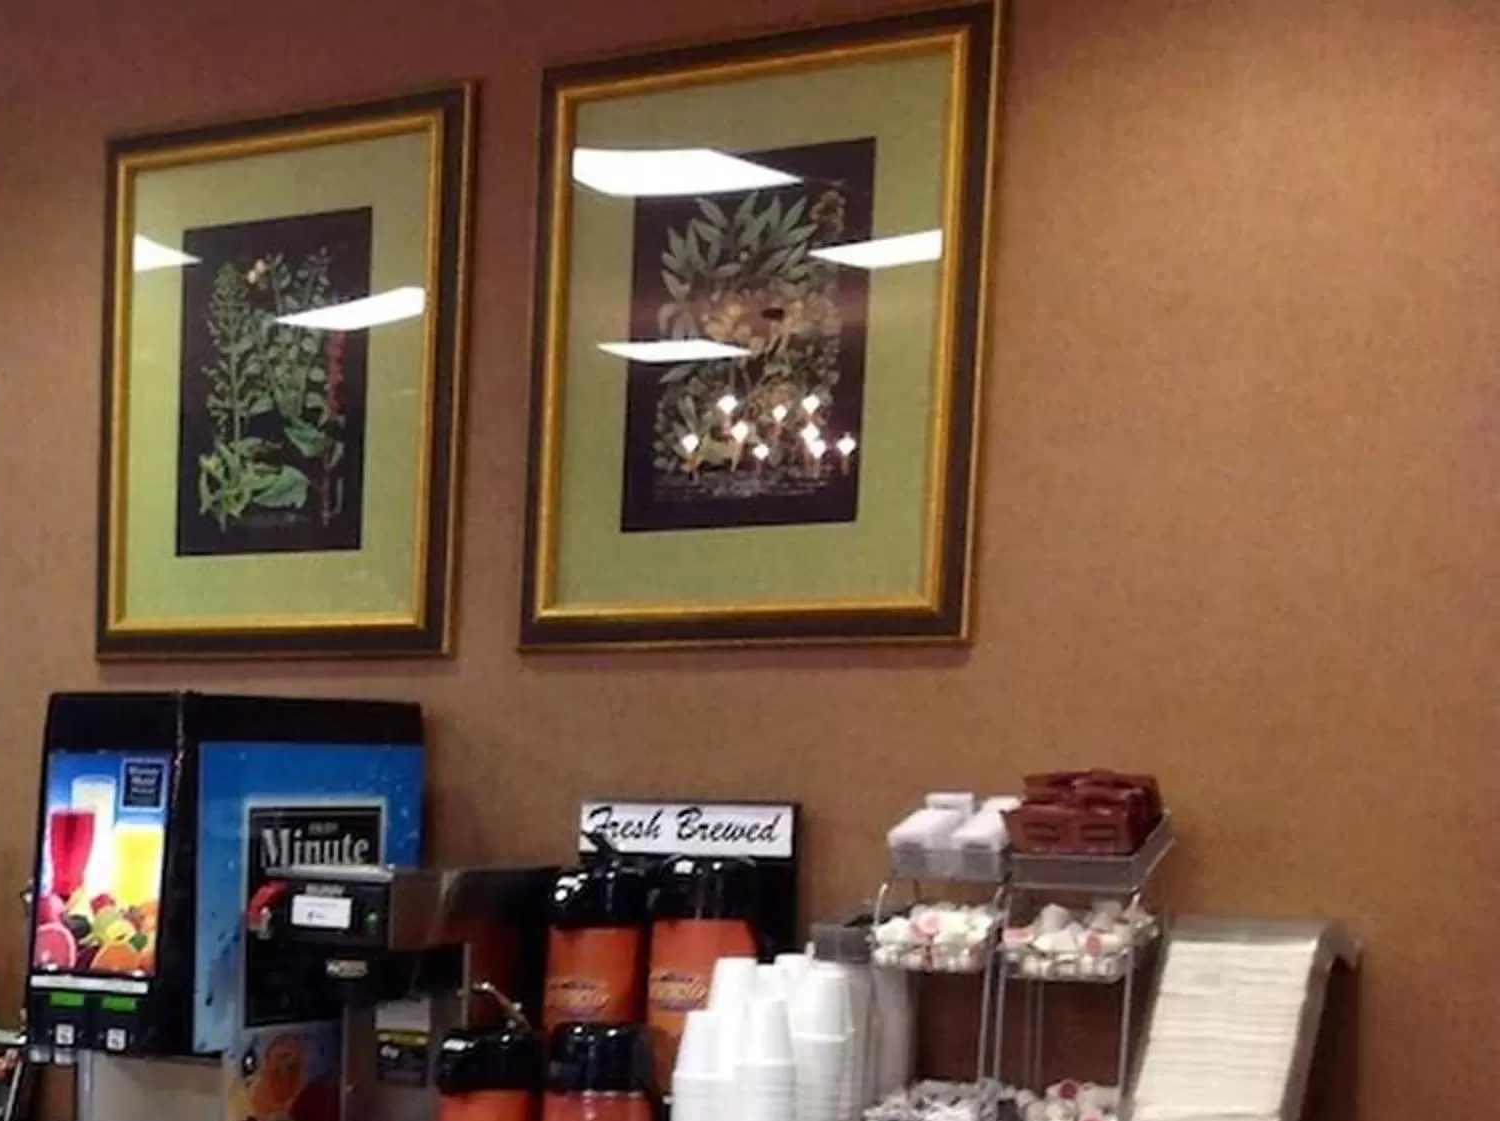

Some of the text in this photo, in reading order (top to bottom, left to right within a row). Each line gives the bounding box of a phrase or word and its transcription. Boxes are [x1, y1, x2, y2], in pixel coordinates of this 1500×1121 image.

[588, 805, 781, 843] Fresh Brewed
[260, 828, 370, 868] Minute
